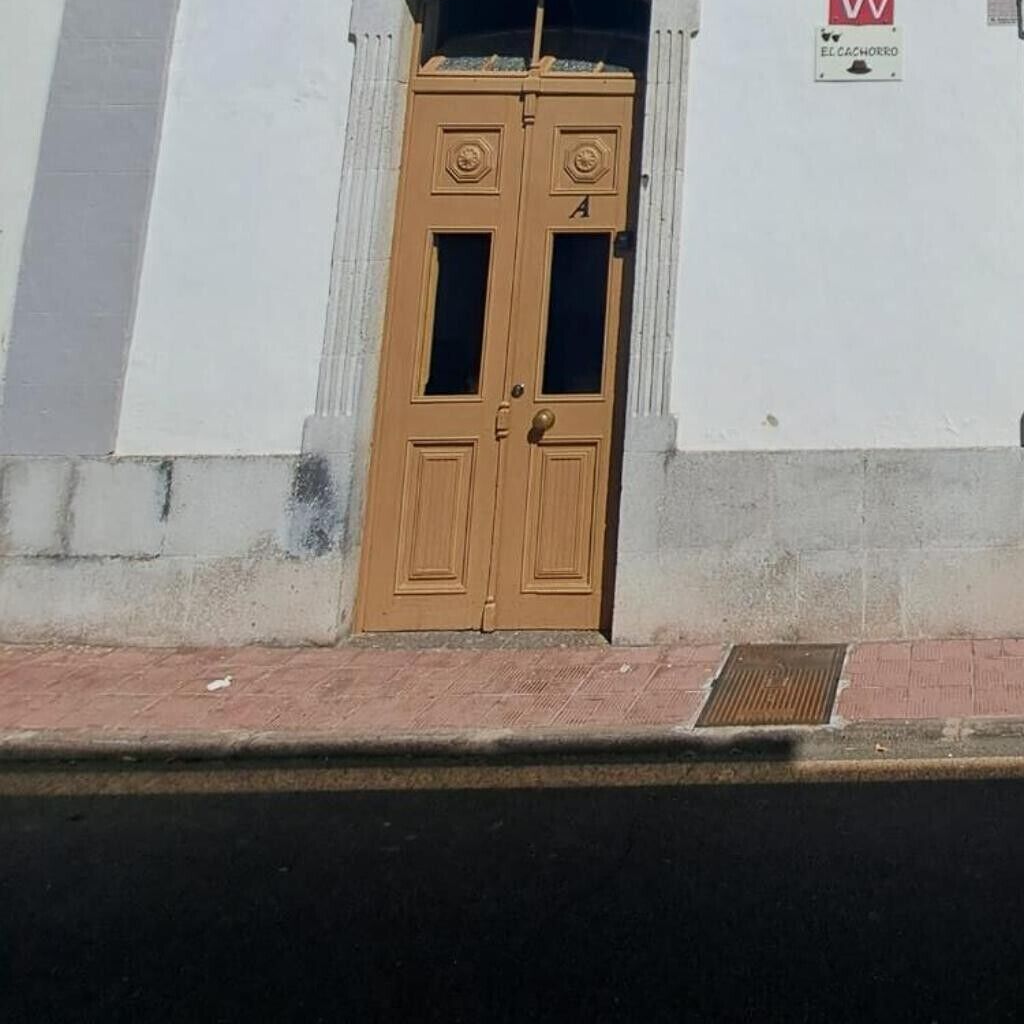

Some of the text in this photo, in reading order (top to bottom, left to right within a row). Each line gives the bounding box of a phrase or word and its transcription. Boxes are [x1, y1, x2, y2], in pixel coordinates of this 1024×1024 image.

[821, 46, 899, 57] EL CACHORRO
[568, 194, 590, 219] A
